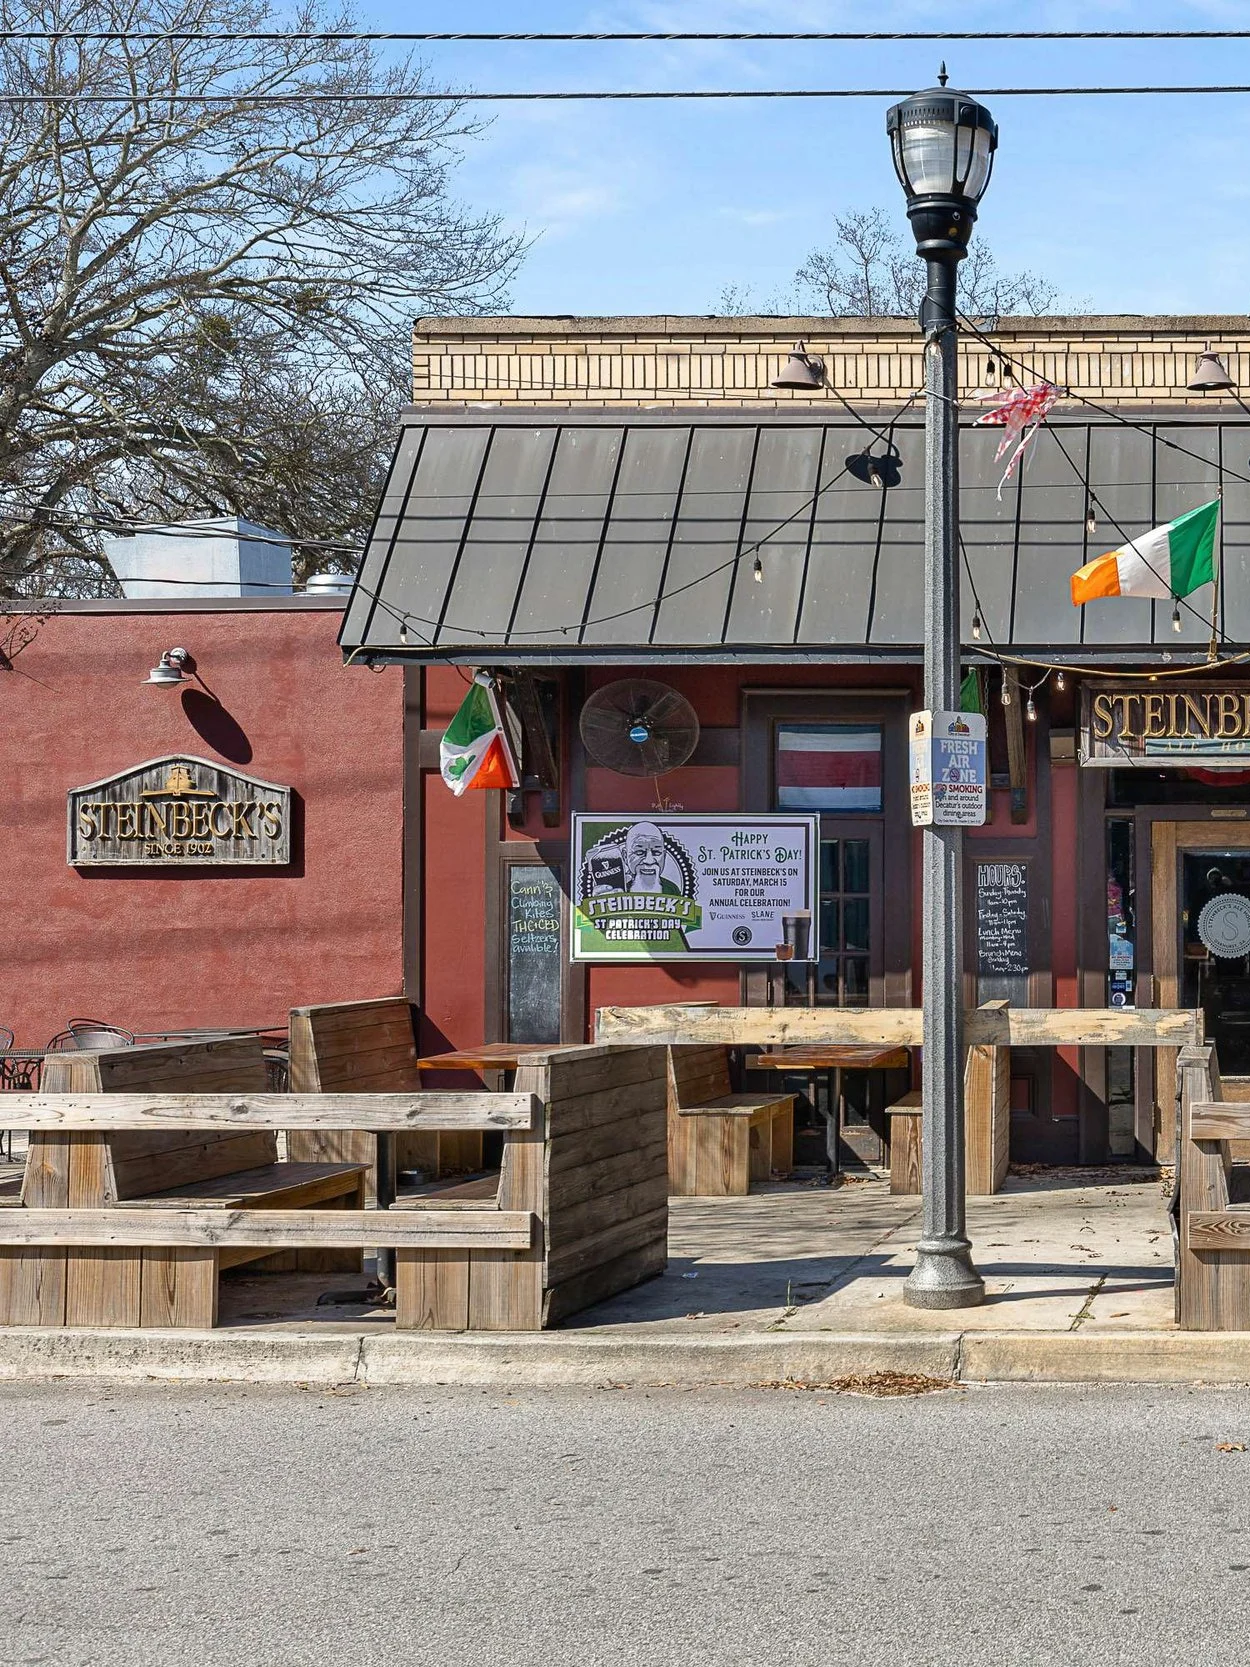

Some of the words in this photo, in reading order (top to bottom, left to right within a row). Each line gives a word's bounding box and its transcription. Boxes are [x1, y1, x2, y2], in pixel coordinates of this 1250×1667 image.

[940, 740, 978, 755] FRESH
[1163, 741, 1201, 751] ALE
[949, 754, 970, 768] AIR
[948, 784, 983, 793] SMOKING
[935, 801, 960, 809] Decatur's
[962, 802, 983, 810] outdoor
[78, 801, 283, 841] STEINBECK'S
[144, 843, 182, 856] SINCE
[185, 843, 214, 856] 1902
[594, 866, 621, 879] GUINNESS
[702, 867, 719, 876] JOIN
[720, 867, 730, 876] US
[730, 867, 740, 876] AT
[741, 867, 787, 876] STEINBECK'S
[788, 867, 798, 876] ON
[978, 864, 1026, 887] HOURS:
[712, 878, 752, 887] SATURDAY,
[753, 878, 779, 886] MARCH
[780, 878, 787, 886] 15
[734, 888, 749, 897] FOR
[750, 888, 765, 897] OUR
[511, 895, 554, 912] Climbing
[588, 895, 691, 916] STEINBECK'S
[709, 899, 739, 907] ANNUAL
[740, 899, 791, 907] CELEBRATION!
[751, 910, 775, 918] SLANE
[594, 919, 606, 929] ST
[609, 918, 659, 929] PATRICK'S
[661, 919, 681, 929] DAY
[1222, 911, 1238, 941] S
[605, 929, 670, 940] CELEBRATION
